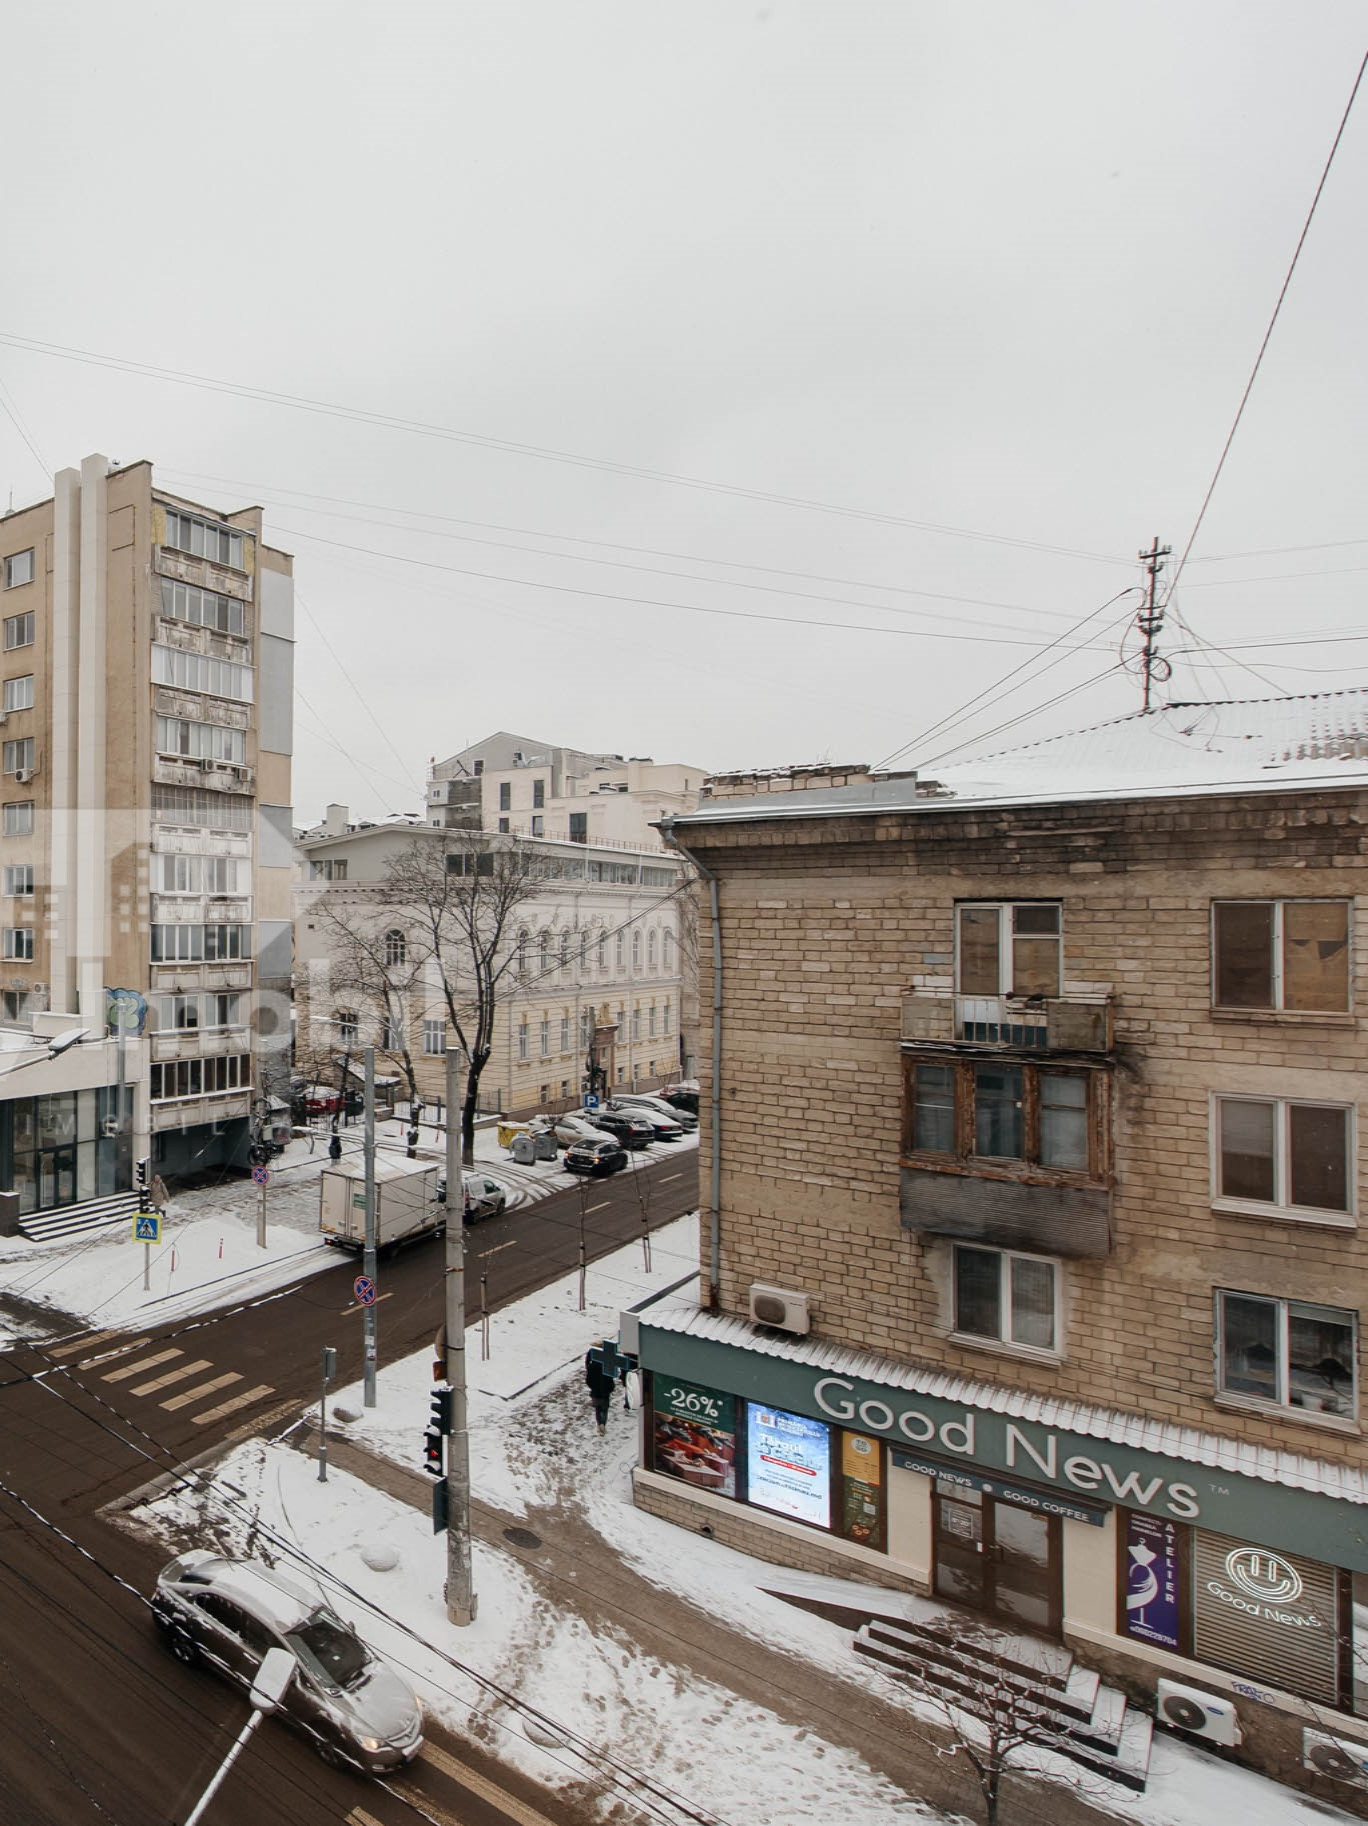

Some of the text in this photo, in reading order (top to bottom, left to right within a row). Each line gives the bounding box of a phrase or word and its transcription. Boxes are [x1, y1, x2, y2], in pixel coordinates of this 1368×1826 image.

[587, 1095, 597, 1106] P
[813, 1376, 1201, 1518] Good News
[903, 1460, 1090, 1523] GOOD NEWS GOOD COFFEE
[1164, 1522, 1175, 1604] ATELIER
[1207, 1581, 1322, 1628] Good News
